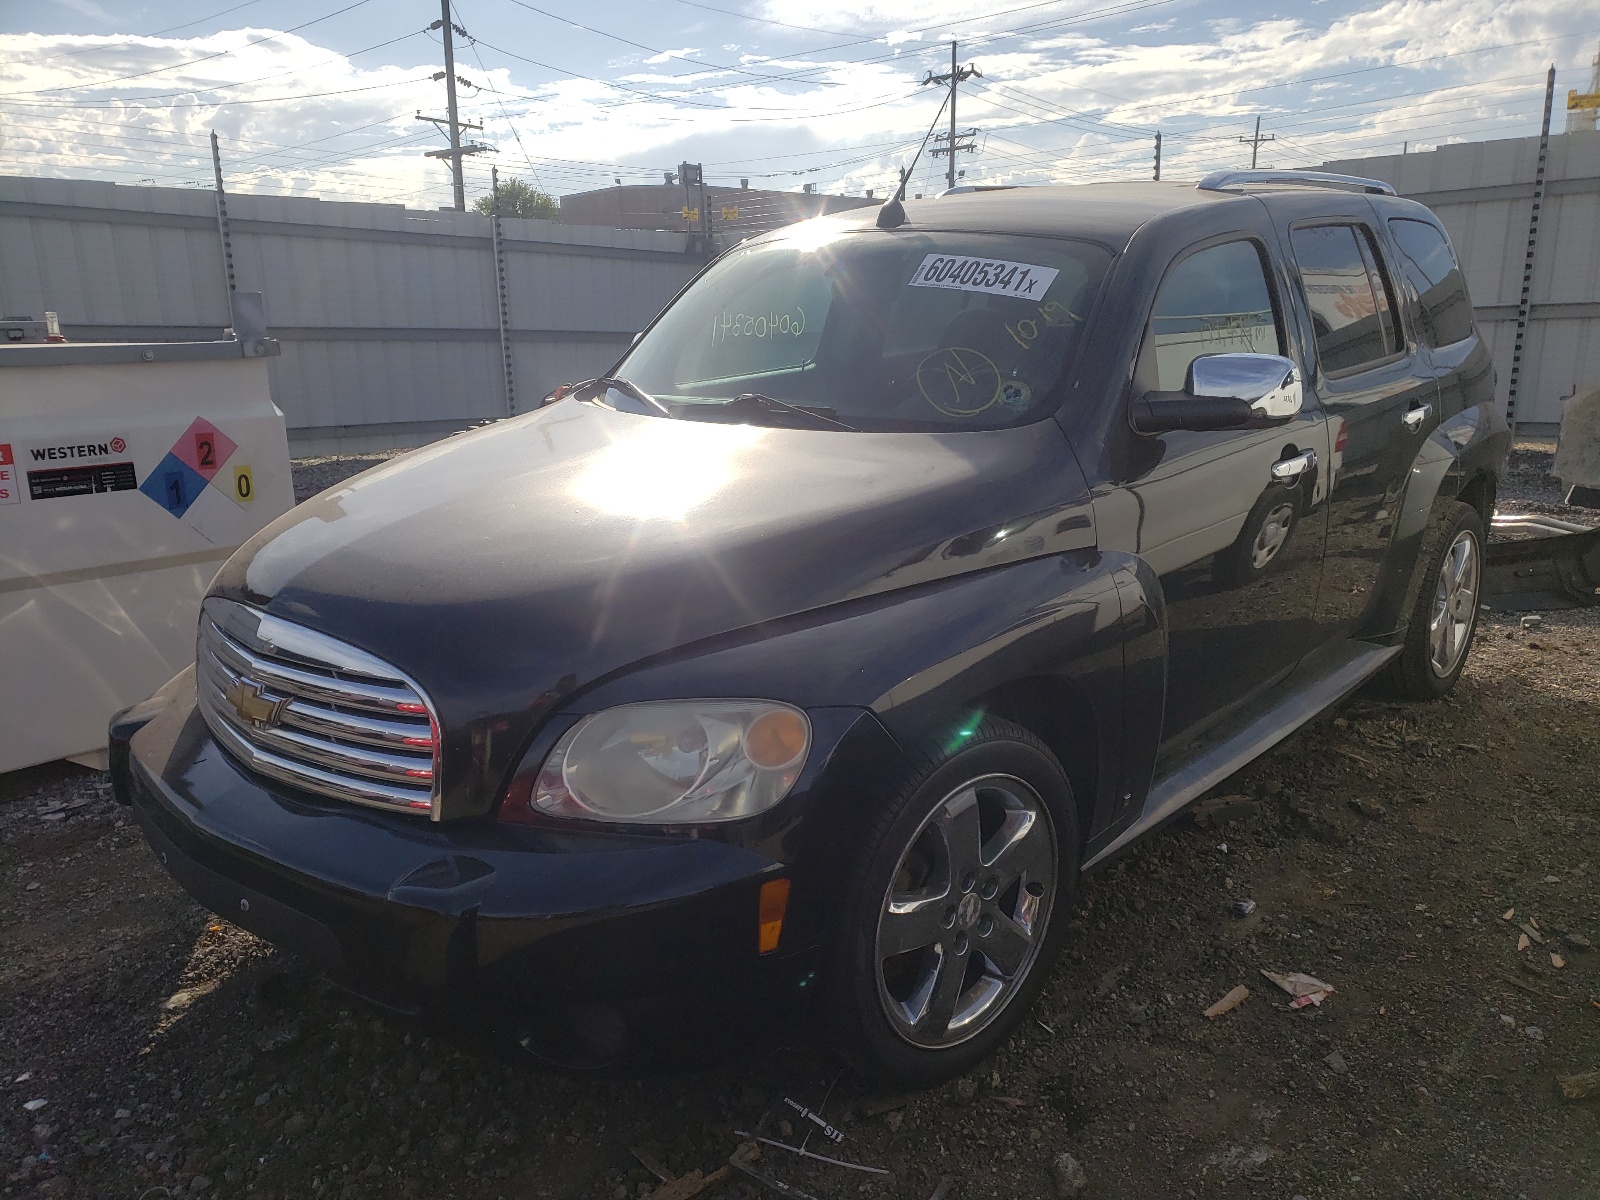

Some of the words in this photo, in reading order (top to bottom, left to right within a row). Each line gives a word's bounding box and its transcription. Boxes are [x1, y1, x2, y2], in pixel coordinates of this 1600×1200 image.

[30, 443, 109, 461] WESTERN
[199, 440, 214, 465] 2
[169, 480, 182, 504] 1
[237, 474, 250, 497] 0
